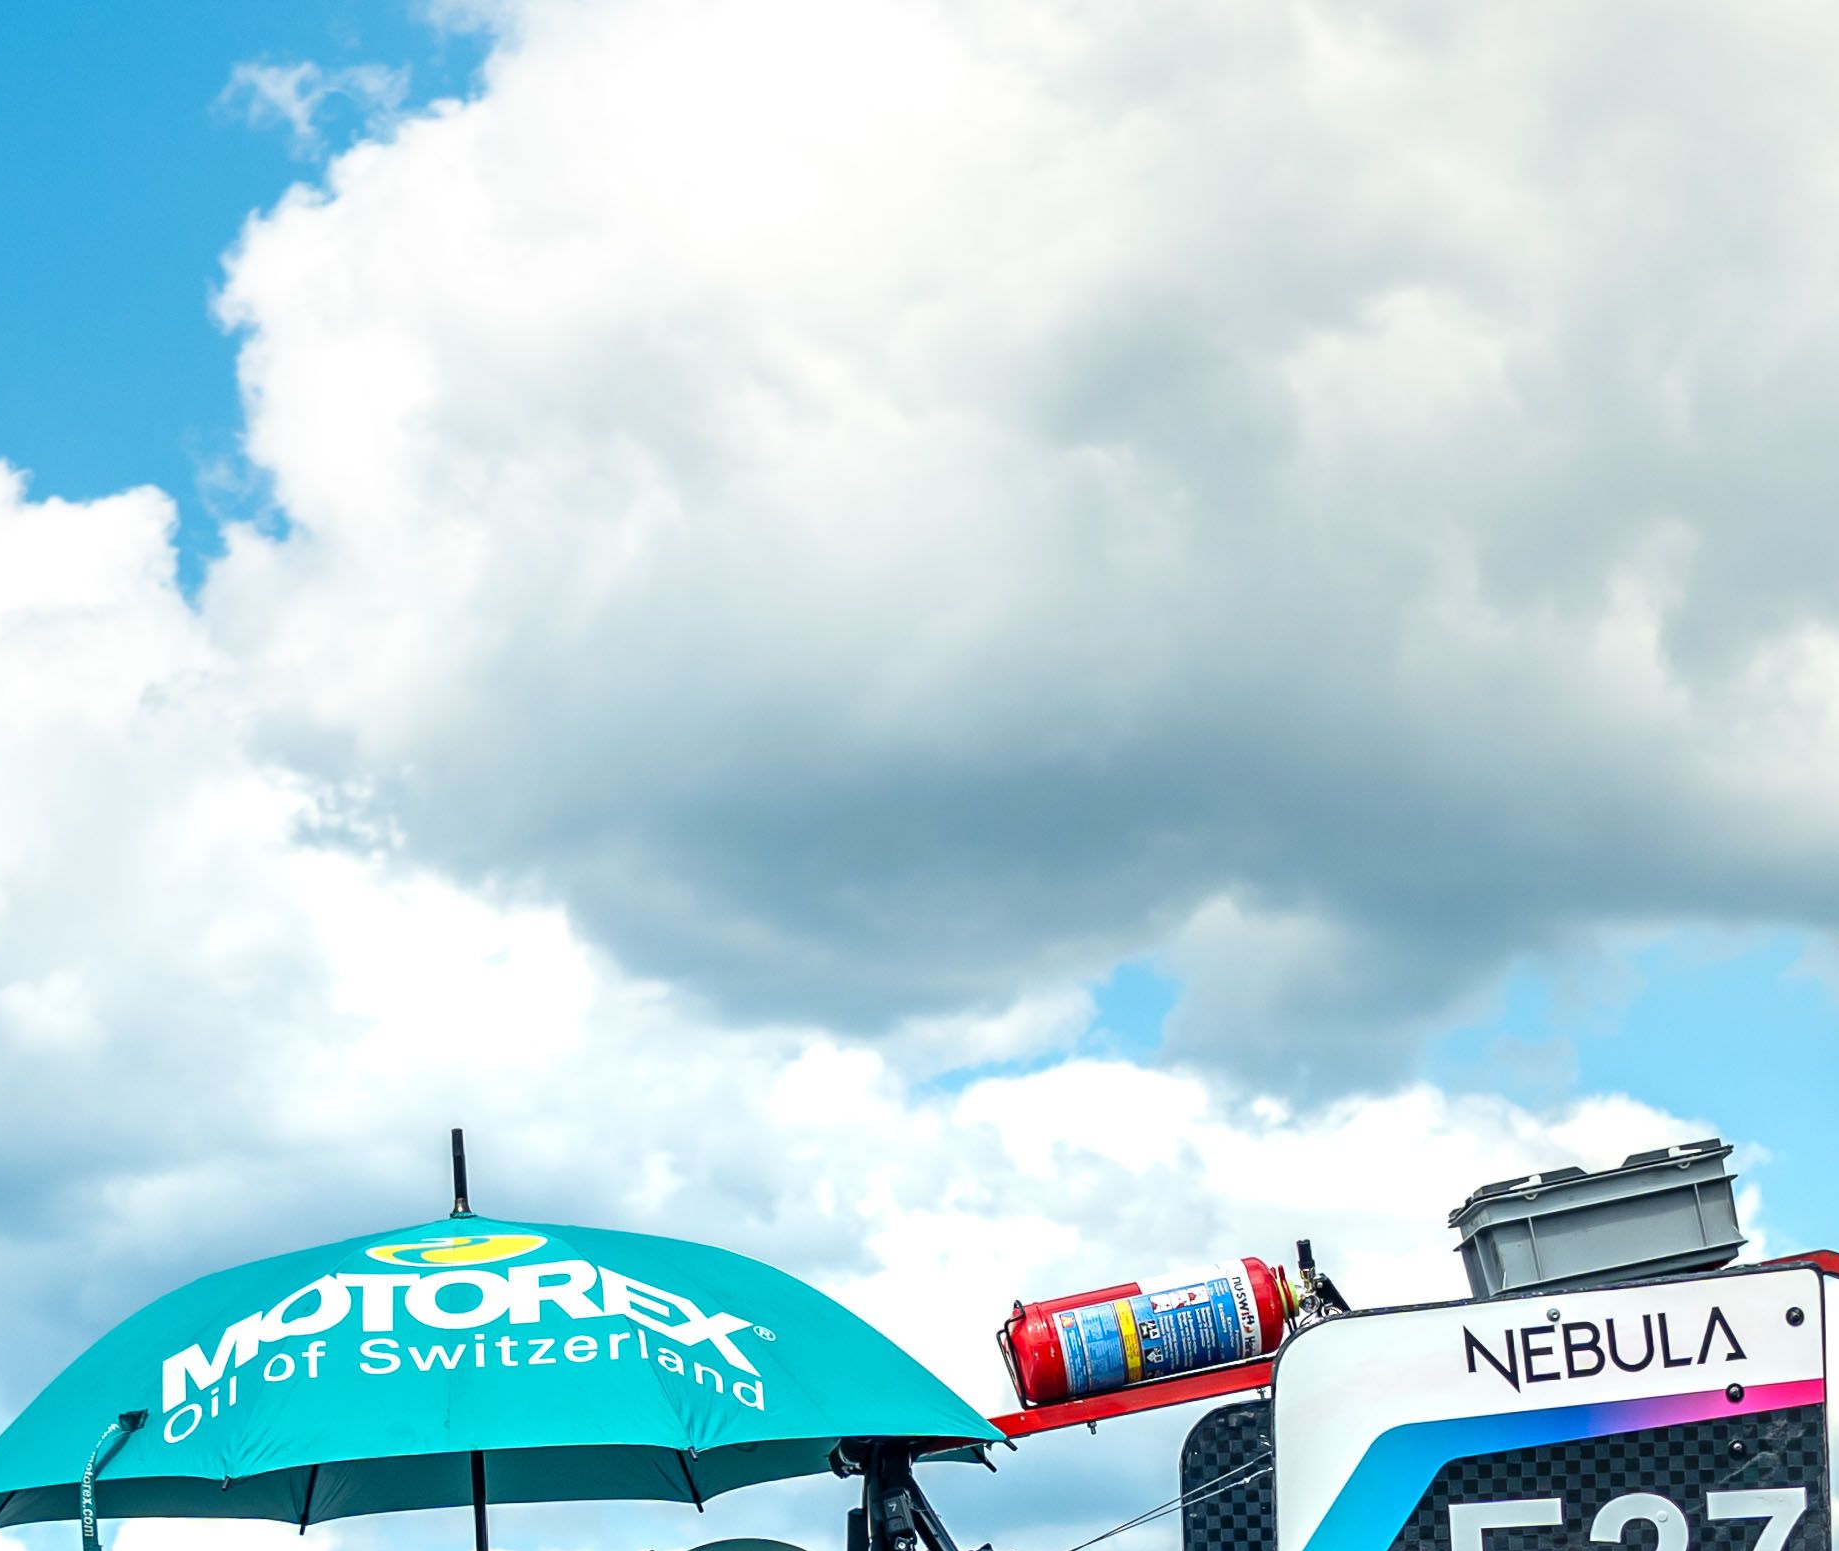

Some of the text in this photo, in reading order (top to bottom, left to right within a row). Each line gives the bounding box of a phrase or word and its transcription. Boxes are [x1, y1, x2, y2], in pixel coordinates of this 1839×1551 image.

[163, 1328, 765, 1444] Oil of Switzerland
[1464, 1306, 1748, 1393] NEBULA
